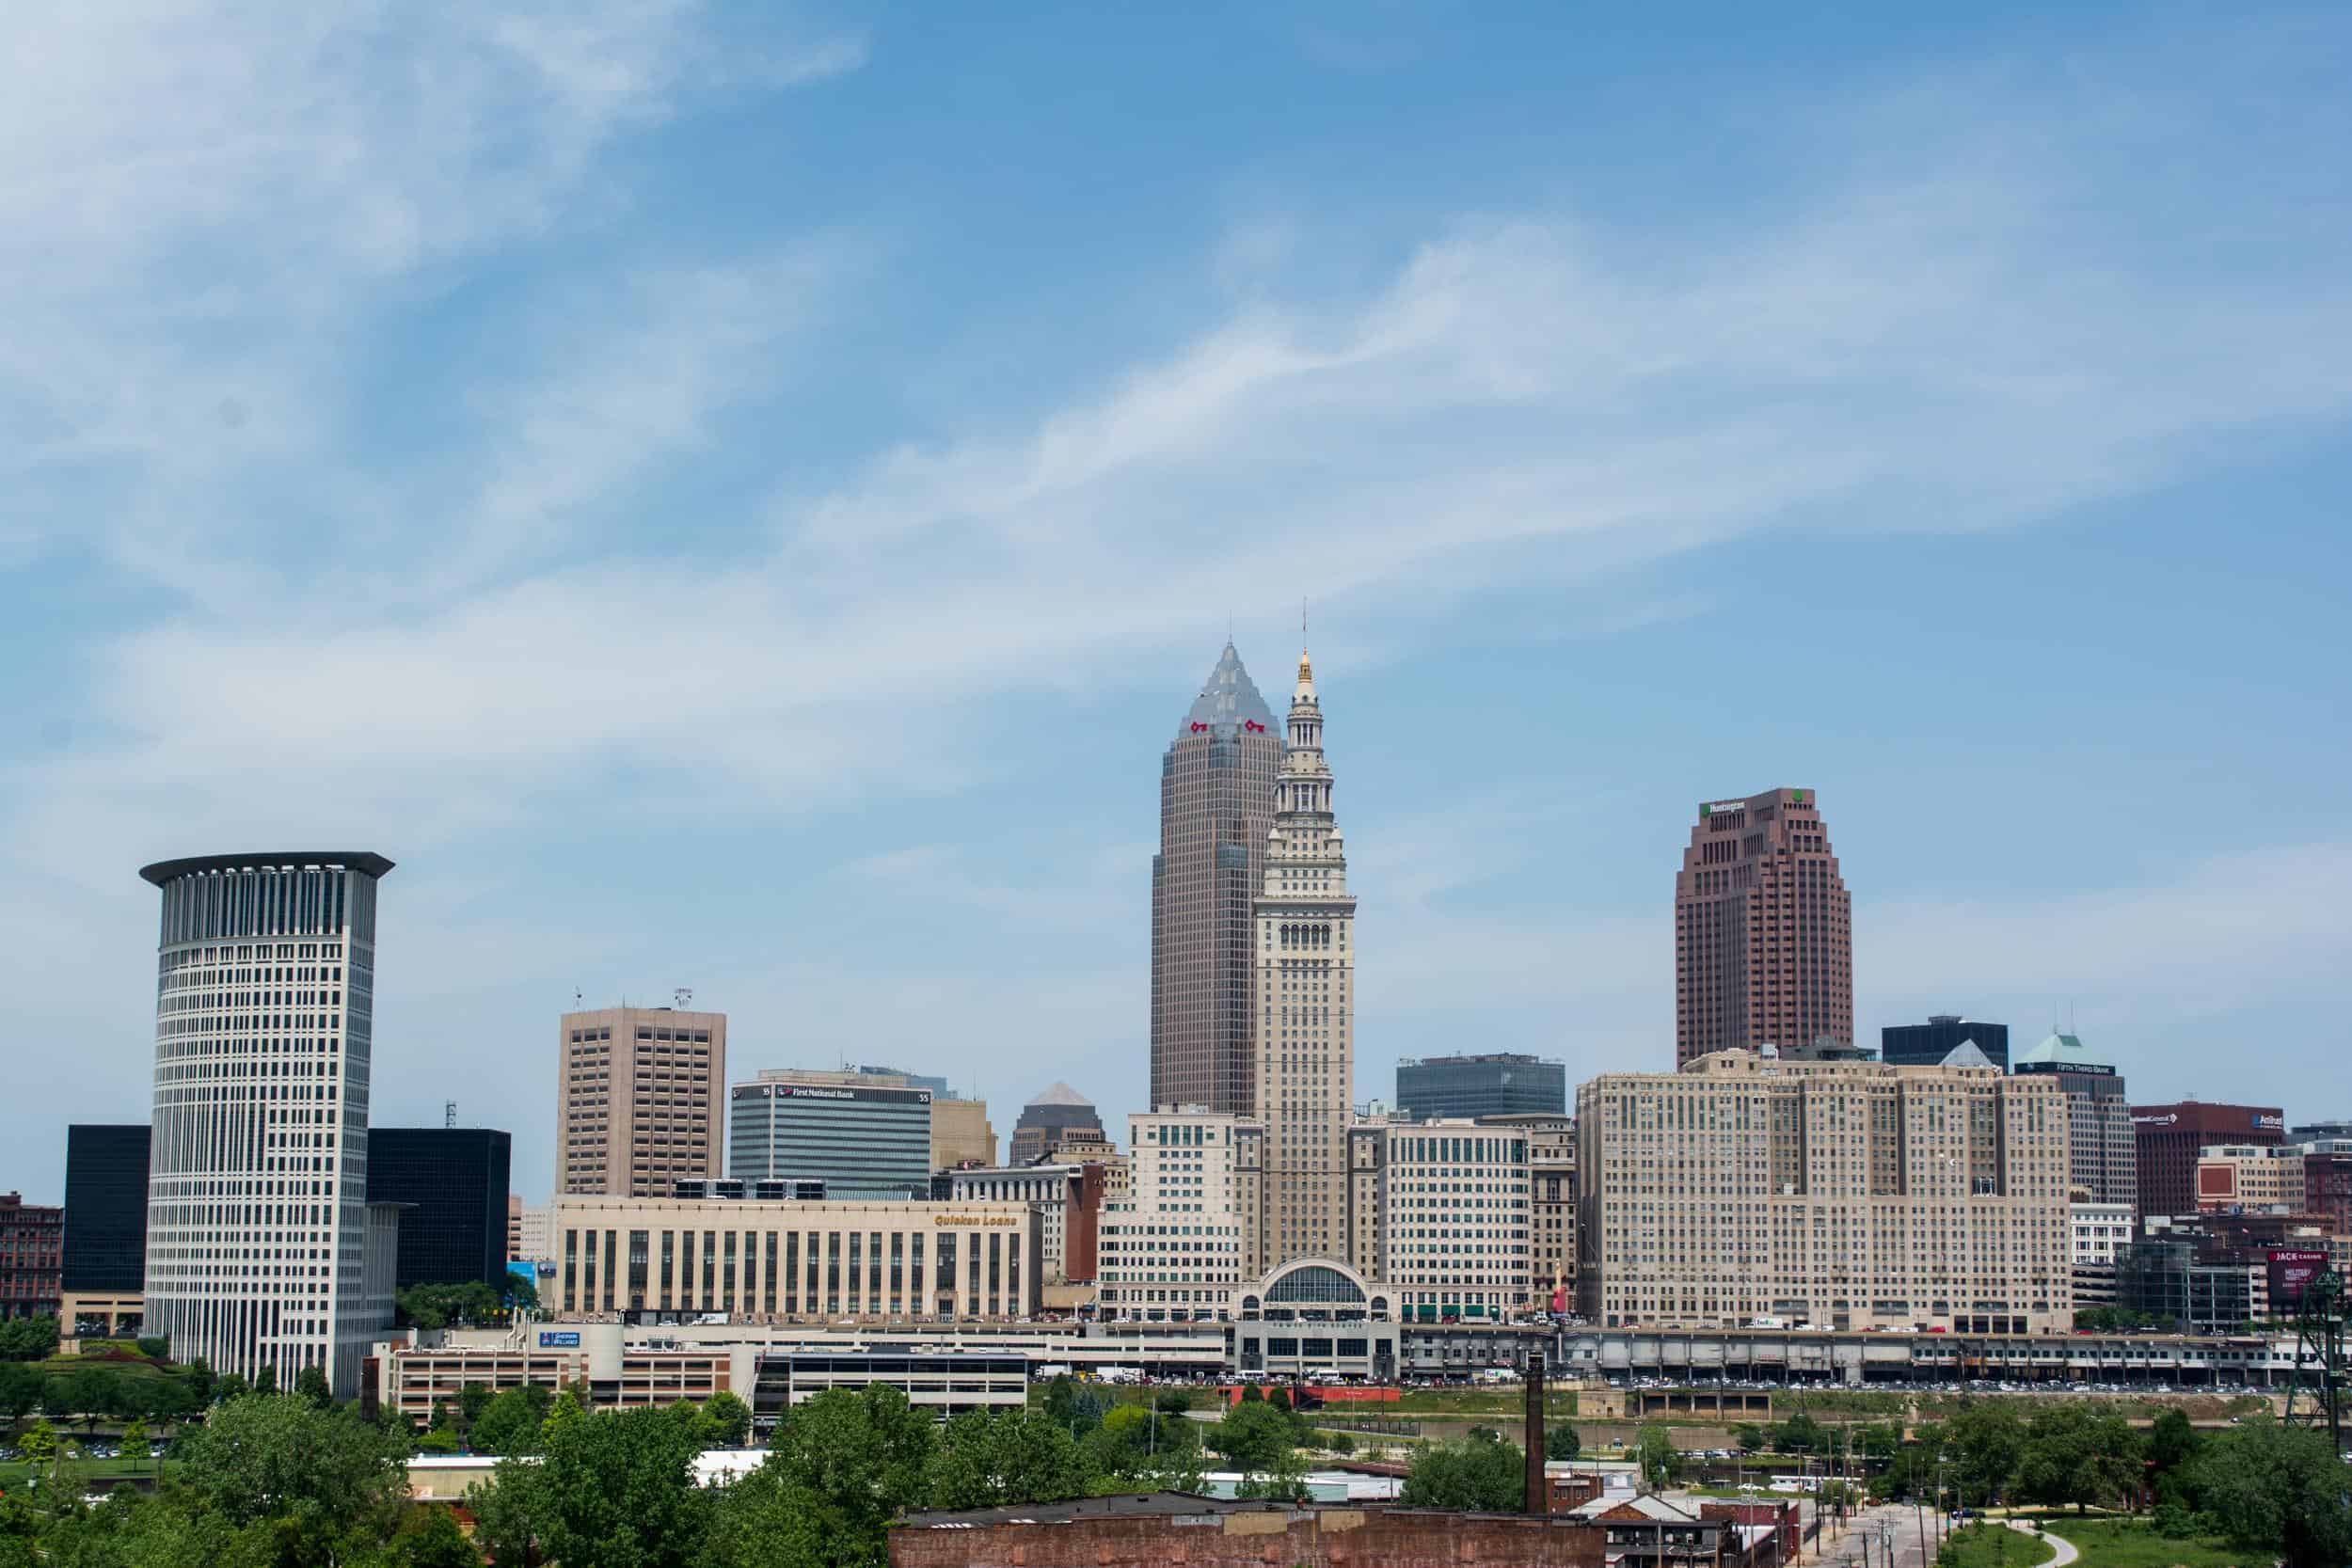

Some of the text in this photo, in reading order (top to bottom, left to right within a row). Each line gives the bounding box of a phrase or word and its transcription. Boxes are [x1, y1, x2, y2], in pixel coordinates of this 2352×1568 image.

[1709, 801, 1745, 814] Huntington
[792, 1088, 854, 1099] First National Bank
[918, 1093, 929, 1102] 55
[934, 1215, 1017, 1227] Quicken Loans
[2277, 1252, 2297, 1261] JACK
